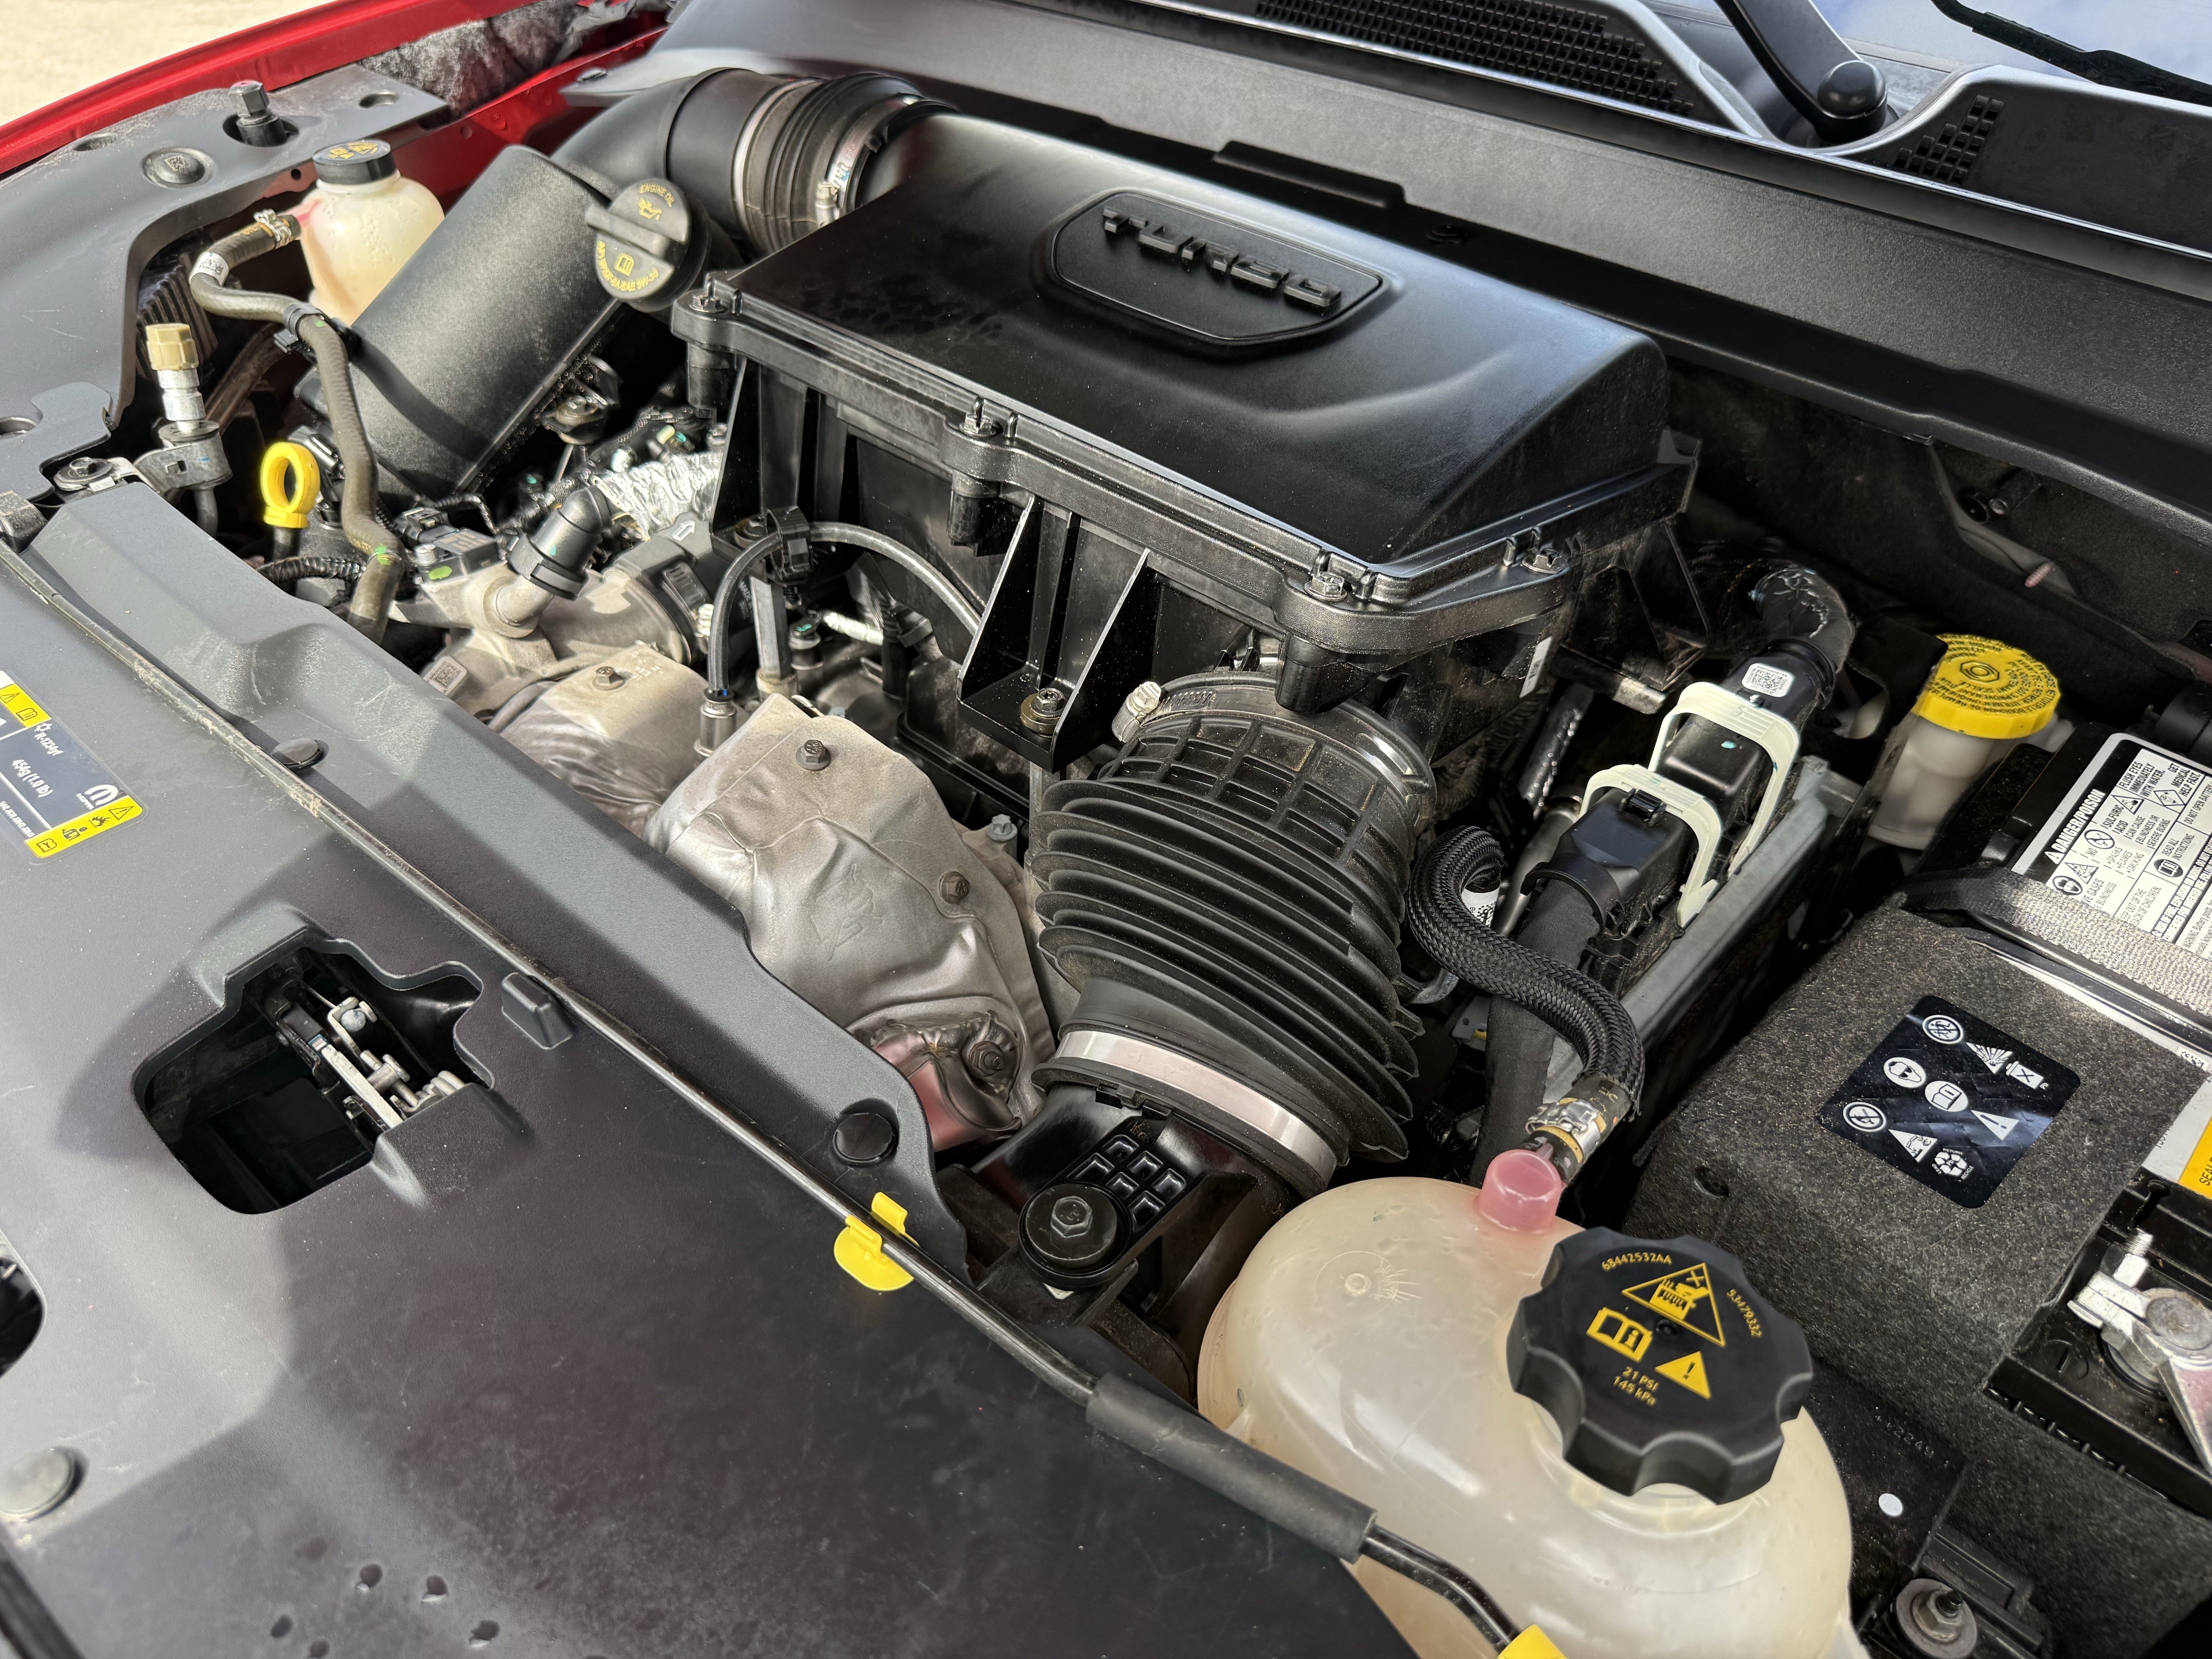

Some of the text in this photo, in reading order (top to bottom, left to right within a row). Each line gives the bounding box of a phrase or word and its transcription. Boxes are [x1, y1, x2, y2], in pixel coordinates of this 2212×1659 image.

[640, 184, 674, 208] ENGINE OIL
[1103, 206, 1341, 309] TURBO
[12, 759, 53, 799] 454g (1.0 lb)
[2119, 761, 2143, 788] FLUSH EYES
[2129, 763, 2155, 793] IMMEDIATELY
[2167, 763, 2180, 773] GET
[2171, 768, 2190, 788] MEDICAL
[2139, 769, 2166, 797] WITH WATER.
[2178, 773, 2201, 797] HELP FAST.
[2051, 788, 2106, 853] DANGER/POISON
[2103, 804, 2124, 828] SULFURIC
[2187, 809, 2199, 819] NOT
[2193, 801, 2205, 812] OPEN
[2116, 820, 2128, 833] ACID
[2127, 815, 2145, 840] CAN CAUSE
[2136, 819, 2155, 843] BLINDNESS
[2147, 819, 2171, 847] SEVERE BURNS.
[2086, 848, 2097, 857] NO
[2162, 838, 2179, 856] READ ALL
[2171, 833, 2195, 860] INSTRUCTIONS.
[2198, 851, 2210, 864] NOT
[2195, 859, 2206, 867] DO
[2087, 878, 2104, 896] GASES
[2096, 882, 2117, 906] BLINDNESS
[2183, 878, 2195, 886] OR
[2126, 902, 2136, 913] OUT
[2135, 888, 2147, 898] THE
[2142, 886, 2162, 908] CHILDREN.
[2170, 883, 2191, 908] EXPLOSION
[2138, 906, 2148, 914] OF
[2160, 914, 2171, 924] OF
[2154, 921, 2169, 933] RISK
[2182, 930, 2200, 949] WARNING:
[2192, 916, 2209, 931] Battery
[2039, 1082, 2049, 1090] Pb
[1942, 1147, 1963, 1156] RETURN
[1961, 1165, 1974, 1180] RECYCLE
[1601, 1252, 1673, 1271] 68442532AA
[1726, 1288, 1762, 1337] 53479332
[1613, 1376, 1657, 1407] 145 kPa
[1622, 1366, 1660, 1393] 21 PSI
